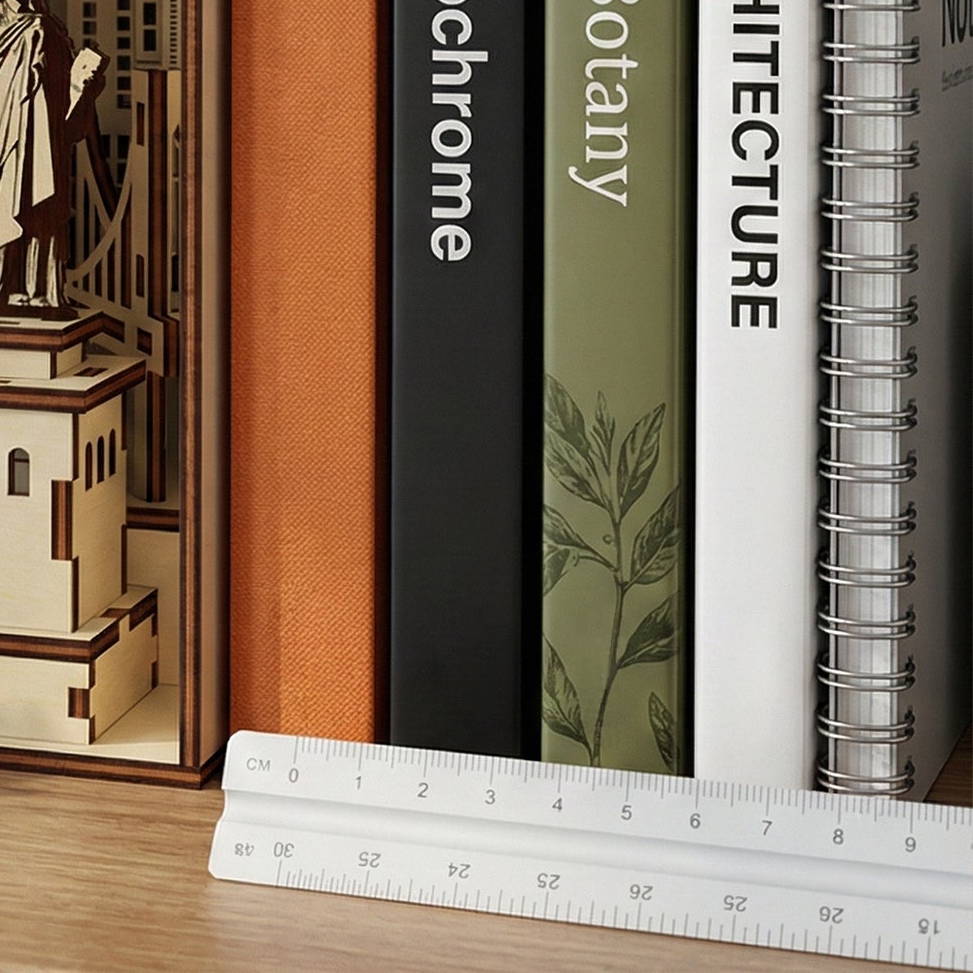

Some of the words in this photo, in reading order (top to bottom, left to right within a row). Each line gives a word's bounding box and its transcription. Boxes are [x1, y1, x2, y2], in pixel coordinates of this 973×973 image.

[246, 757, 272, 772] CM
[288, 768, 299, 784] 0
[355, 775, 363, 790] 1
[417, 782, 429, 798] 2
[484, 789, 496, 805] 3
[552, 797, 563, 813] 4
[620, 805, 632, 821] 5
[689, 813, 701, 829] 6
[761, 820, 773, 836] 7
[832, 828, 844, 845] 8
[905, 836, 917, 853] 9
[273, 841, 295, 858] 30
[358, 851, 382, 868] 25
[448, 862, 471, 879] 24
[537, 873, 561, 890] 25
[629, 883, 654, 901] 26
[723, 894, 748, 912] 25
[819, 905, 845, 924] 26
